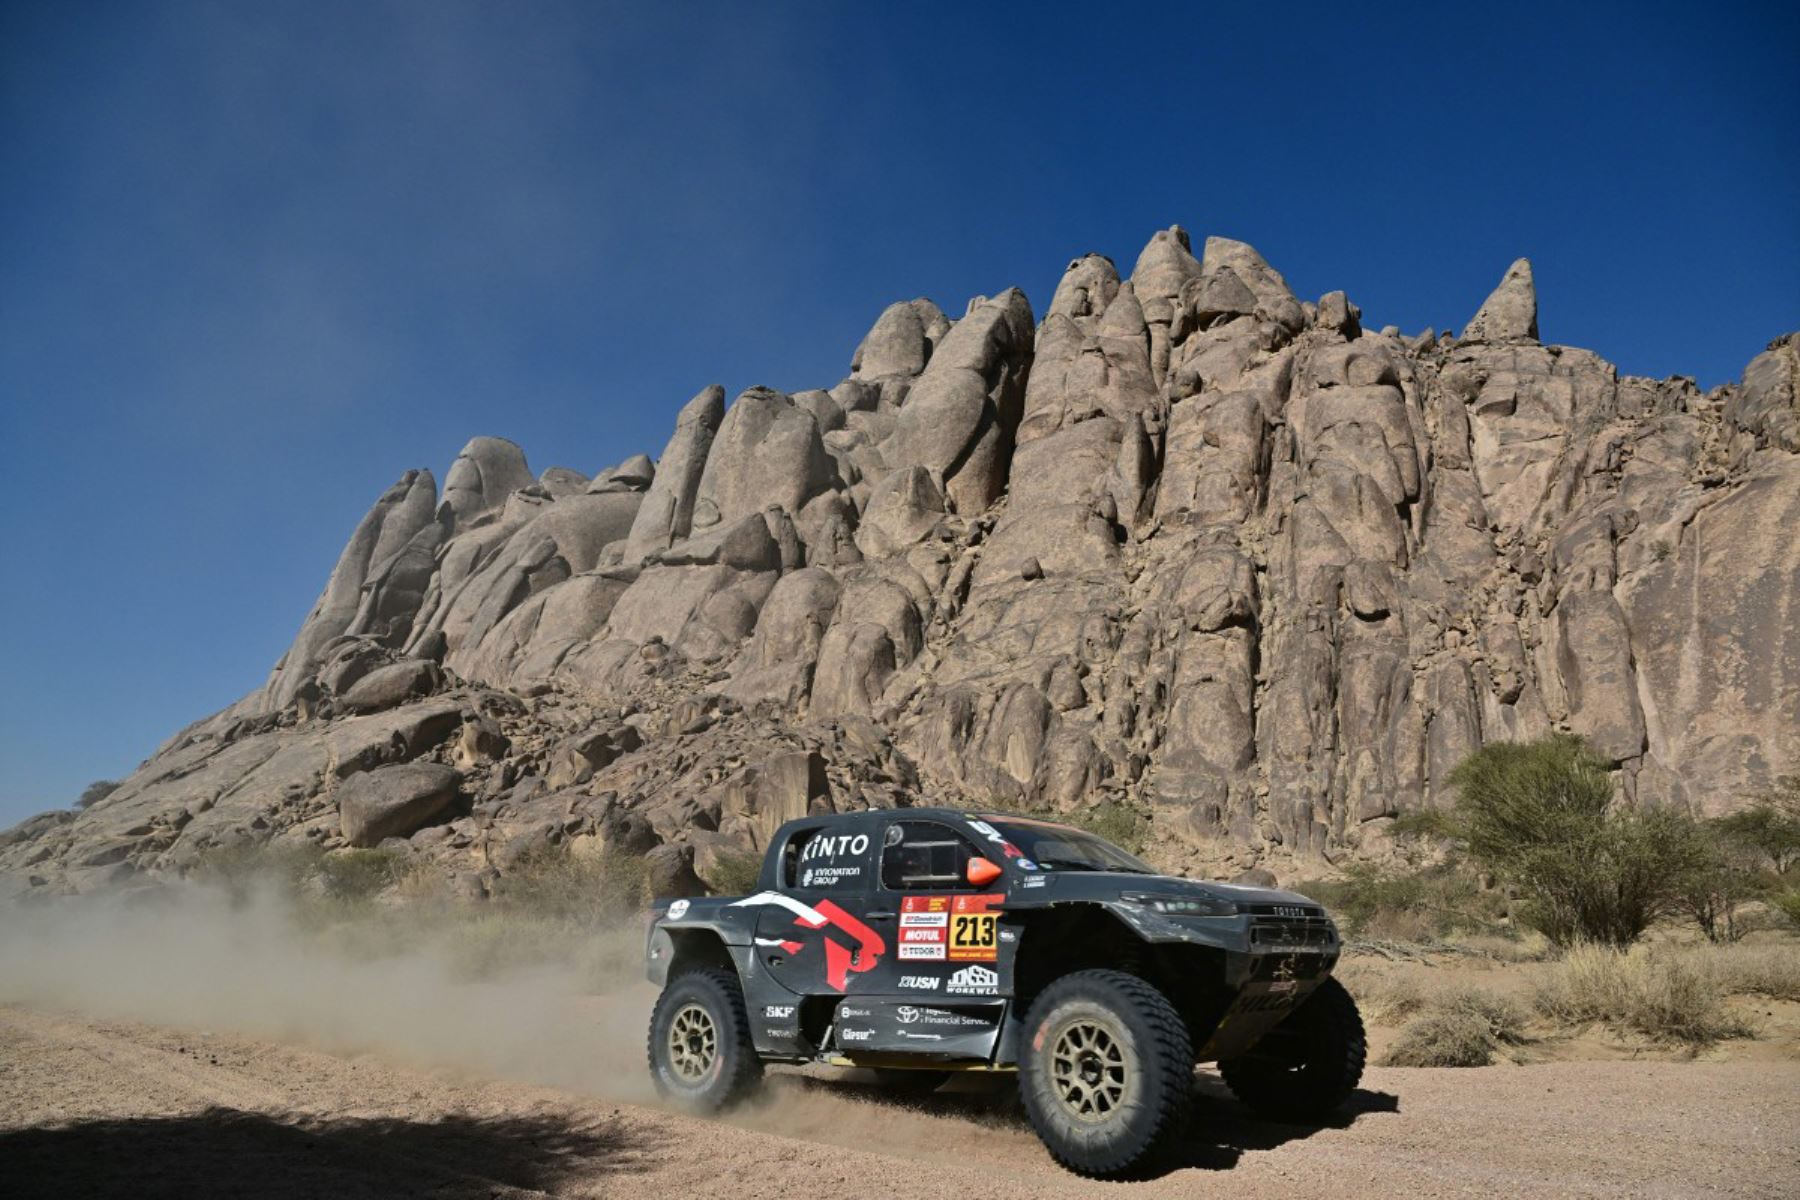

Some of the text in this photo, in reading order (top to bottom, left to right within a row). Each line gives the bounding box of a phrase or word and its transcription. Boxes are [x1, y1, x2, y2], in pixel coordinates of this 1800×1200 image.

[904, 929, 940, 941] MOTUL
[955, 916, 994, 946] 213
[947, 964, 998, 986] JONSSO
[946, 987, 998, 995] WORKWEA
[766, 1005, 795, 1018] SKF
[924, 1016, 960, 1025] Financial
